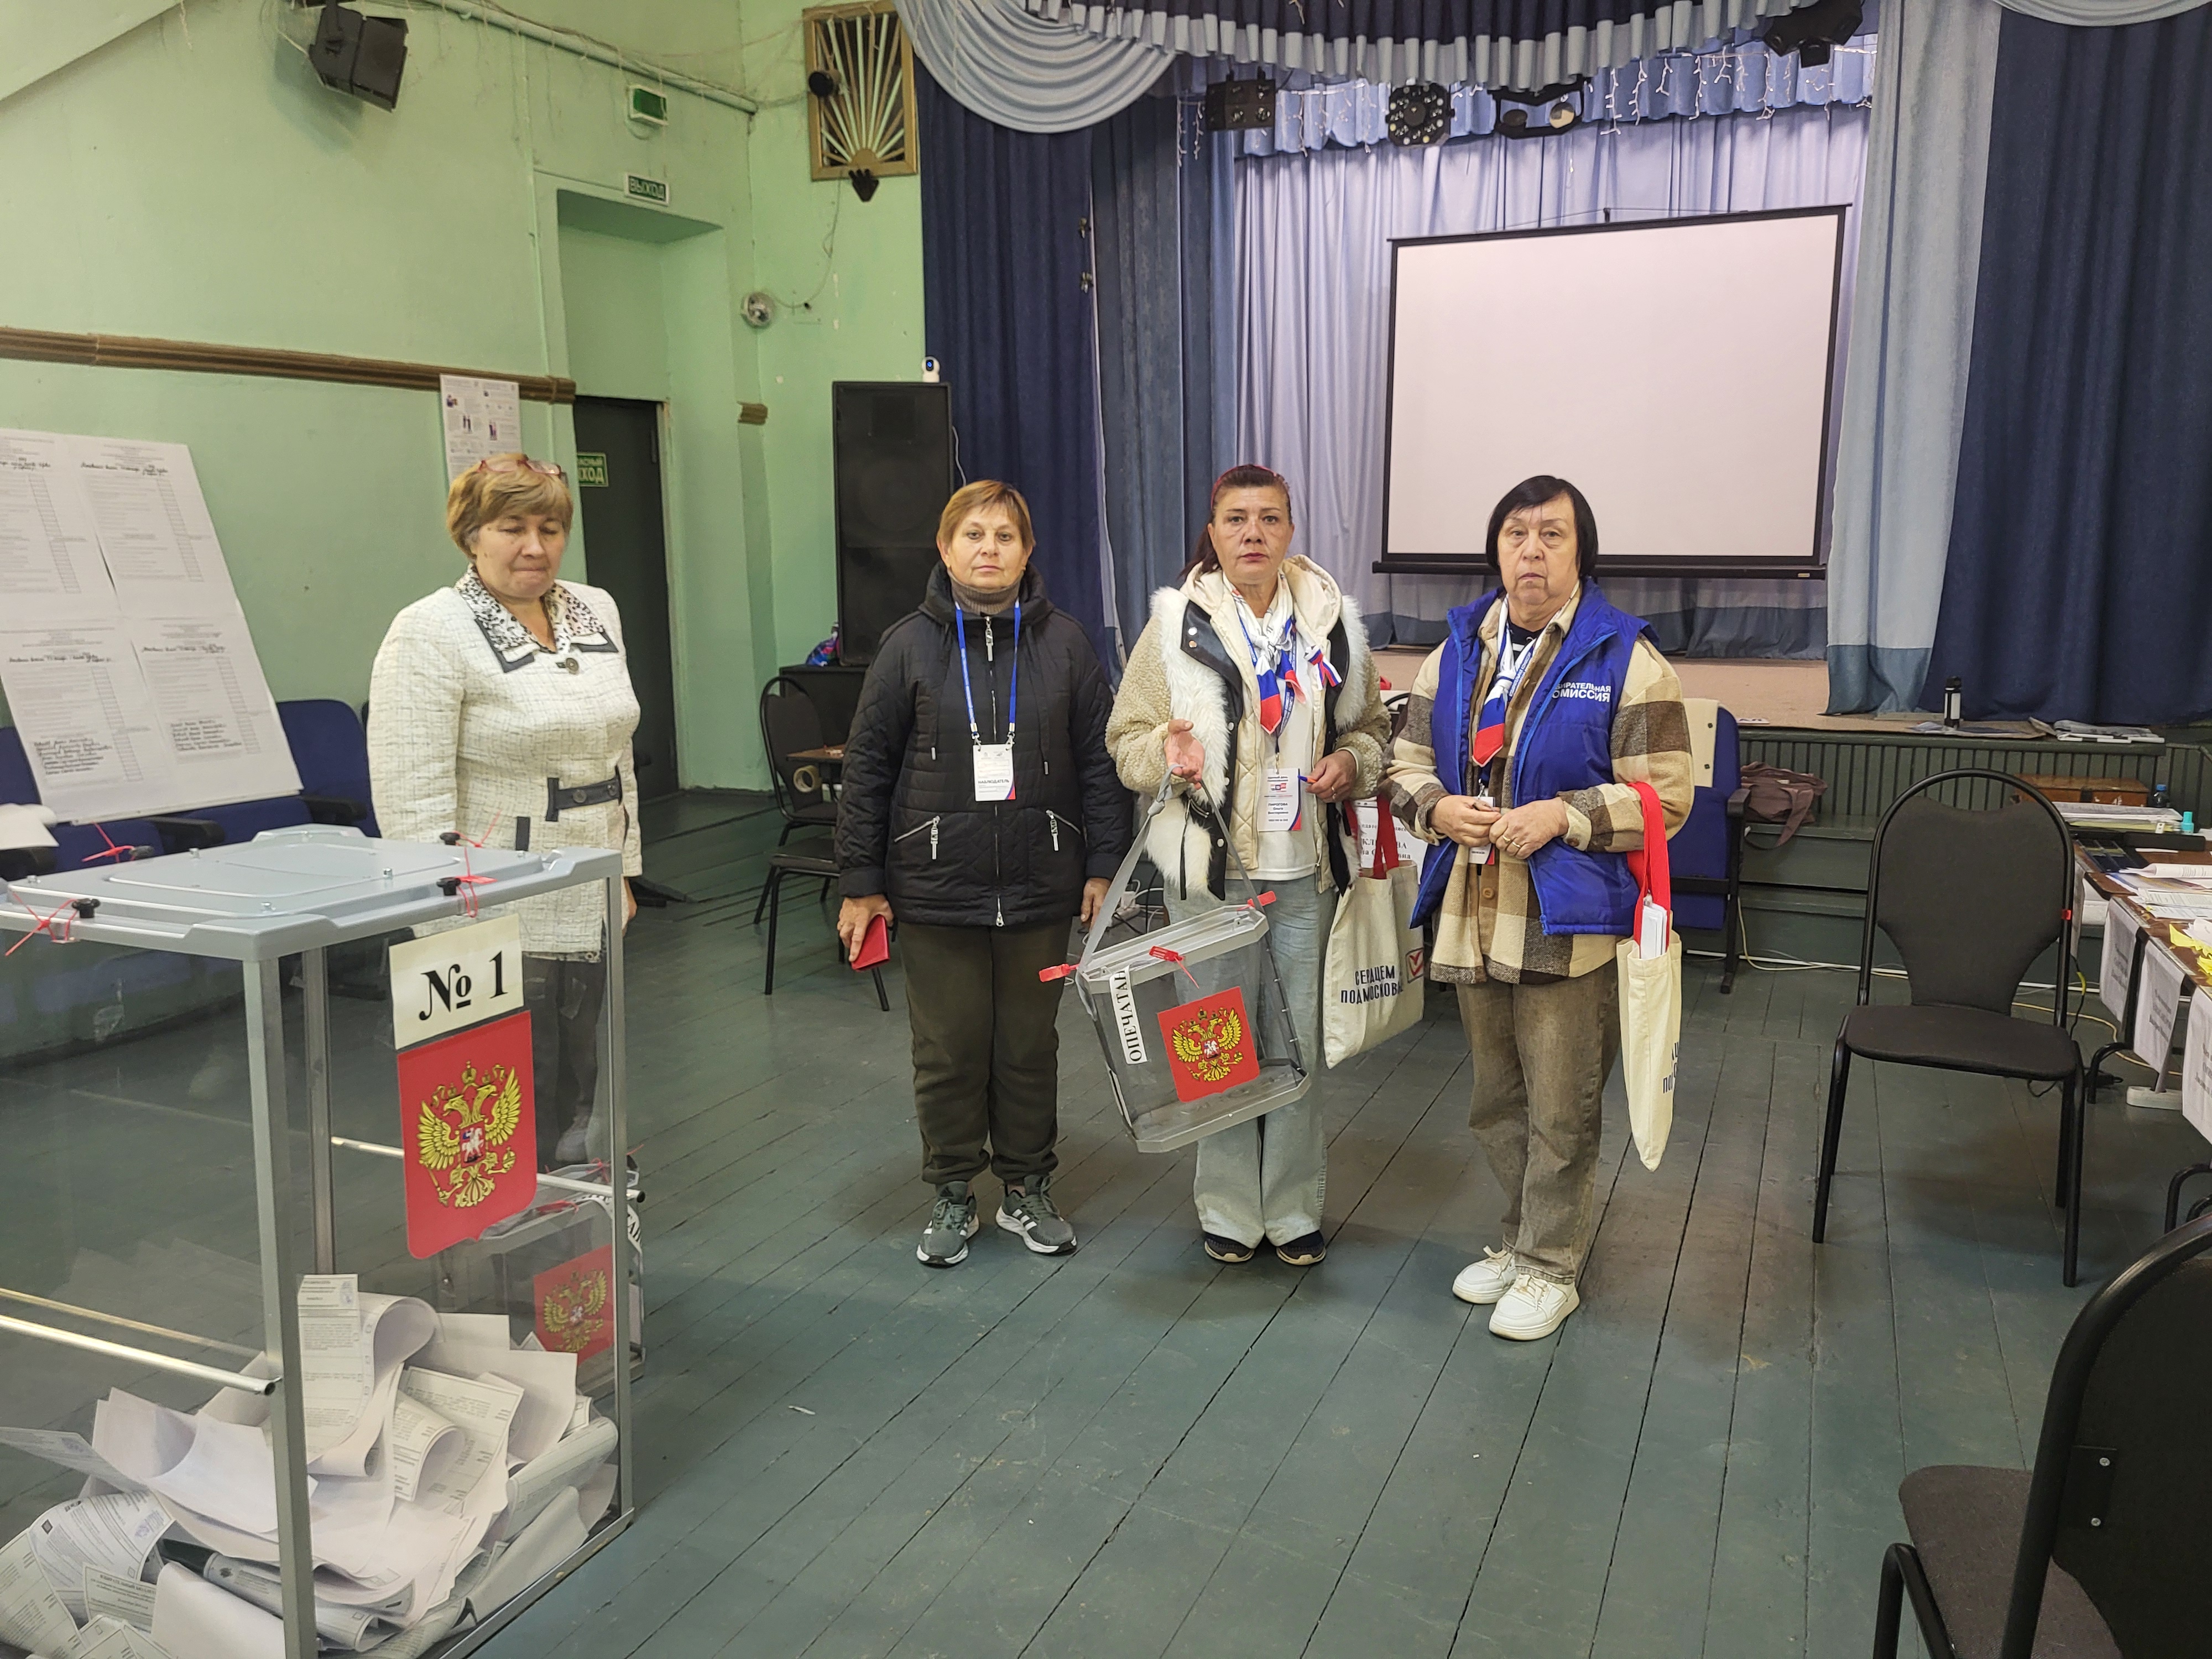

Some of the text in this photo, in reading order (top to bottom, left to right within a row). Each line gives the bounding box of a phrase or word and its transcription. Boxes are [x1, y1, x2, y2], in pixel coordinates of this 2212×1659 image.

[630, 178, 665, 199] ВЫХОД
[578, 467, 604, 484] ХОД
[1552, 688, 1610, 702] ОМИССИЯ
[419, 950, 508, 1021] № 1
